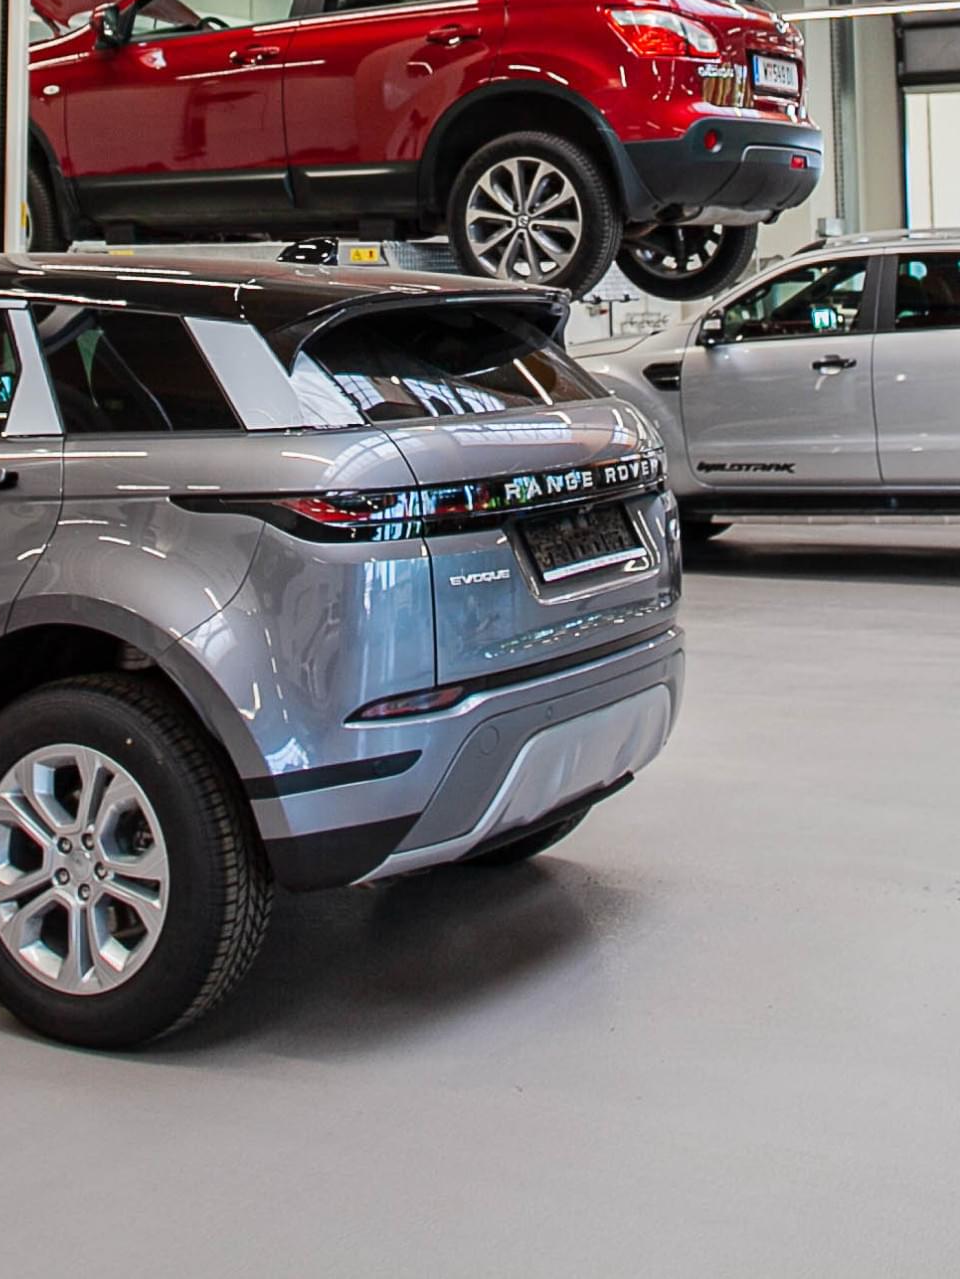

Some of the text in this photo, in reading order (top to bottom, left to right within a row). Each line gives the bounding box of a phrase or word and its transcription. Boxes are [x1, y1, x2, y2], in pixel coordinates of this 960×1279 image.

[504, 458, 659, 501] RANGE ROVER
[449, 569, 511, 586] EVOQUE
